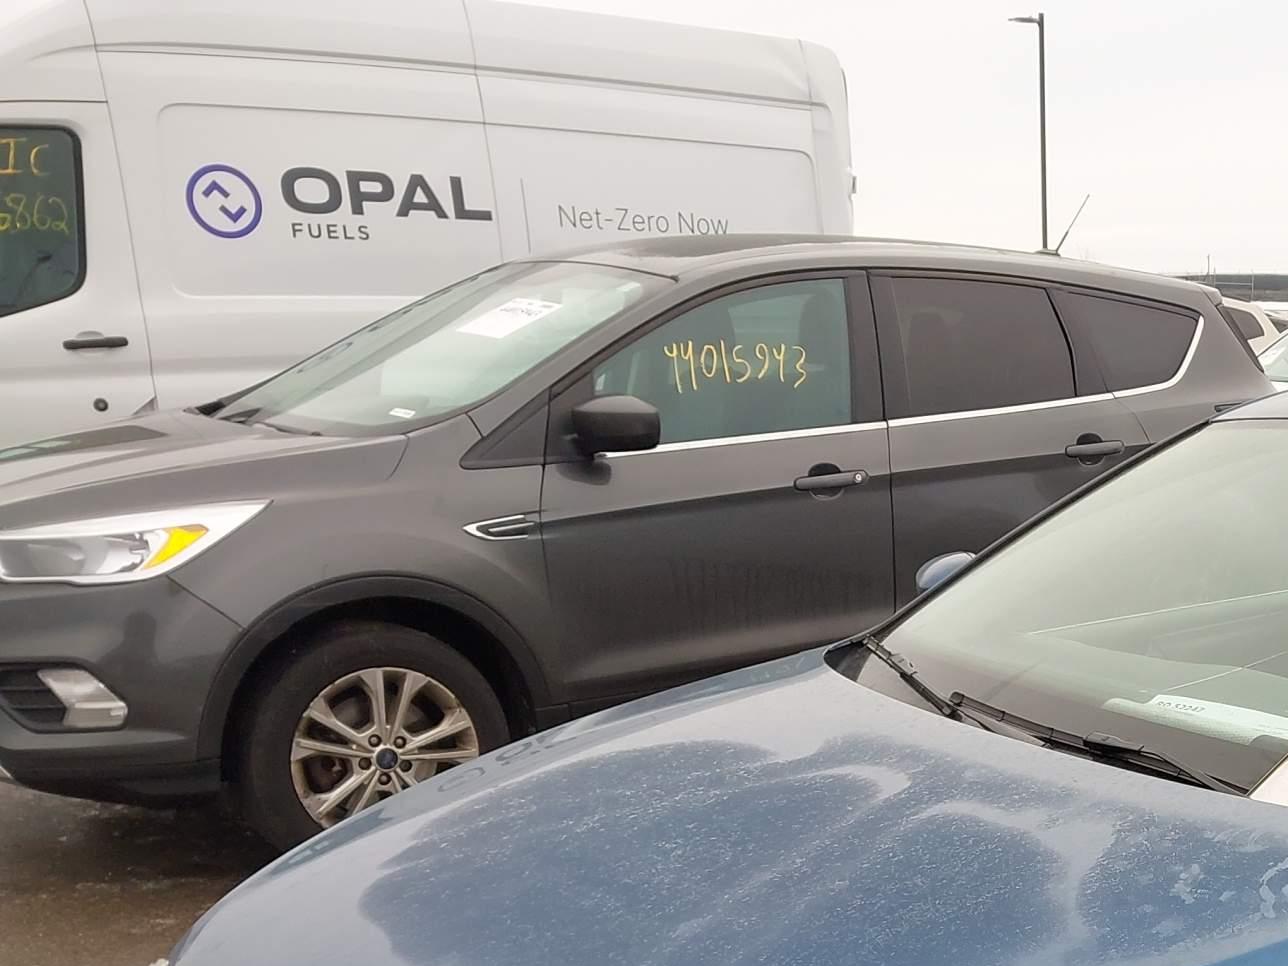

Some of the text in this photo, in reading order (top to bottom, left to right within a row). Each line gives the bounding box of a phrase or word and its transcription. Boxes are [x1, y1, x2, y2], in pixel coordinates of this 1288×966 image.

[280, 166, 493, 221] OPAL
[291, 222, 370, 240] FUELS
[558, 204, 729, 235] Net-Zero Now
[663, 339, 807, 394] 44015943
